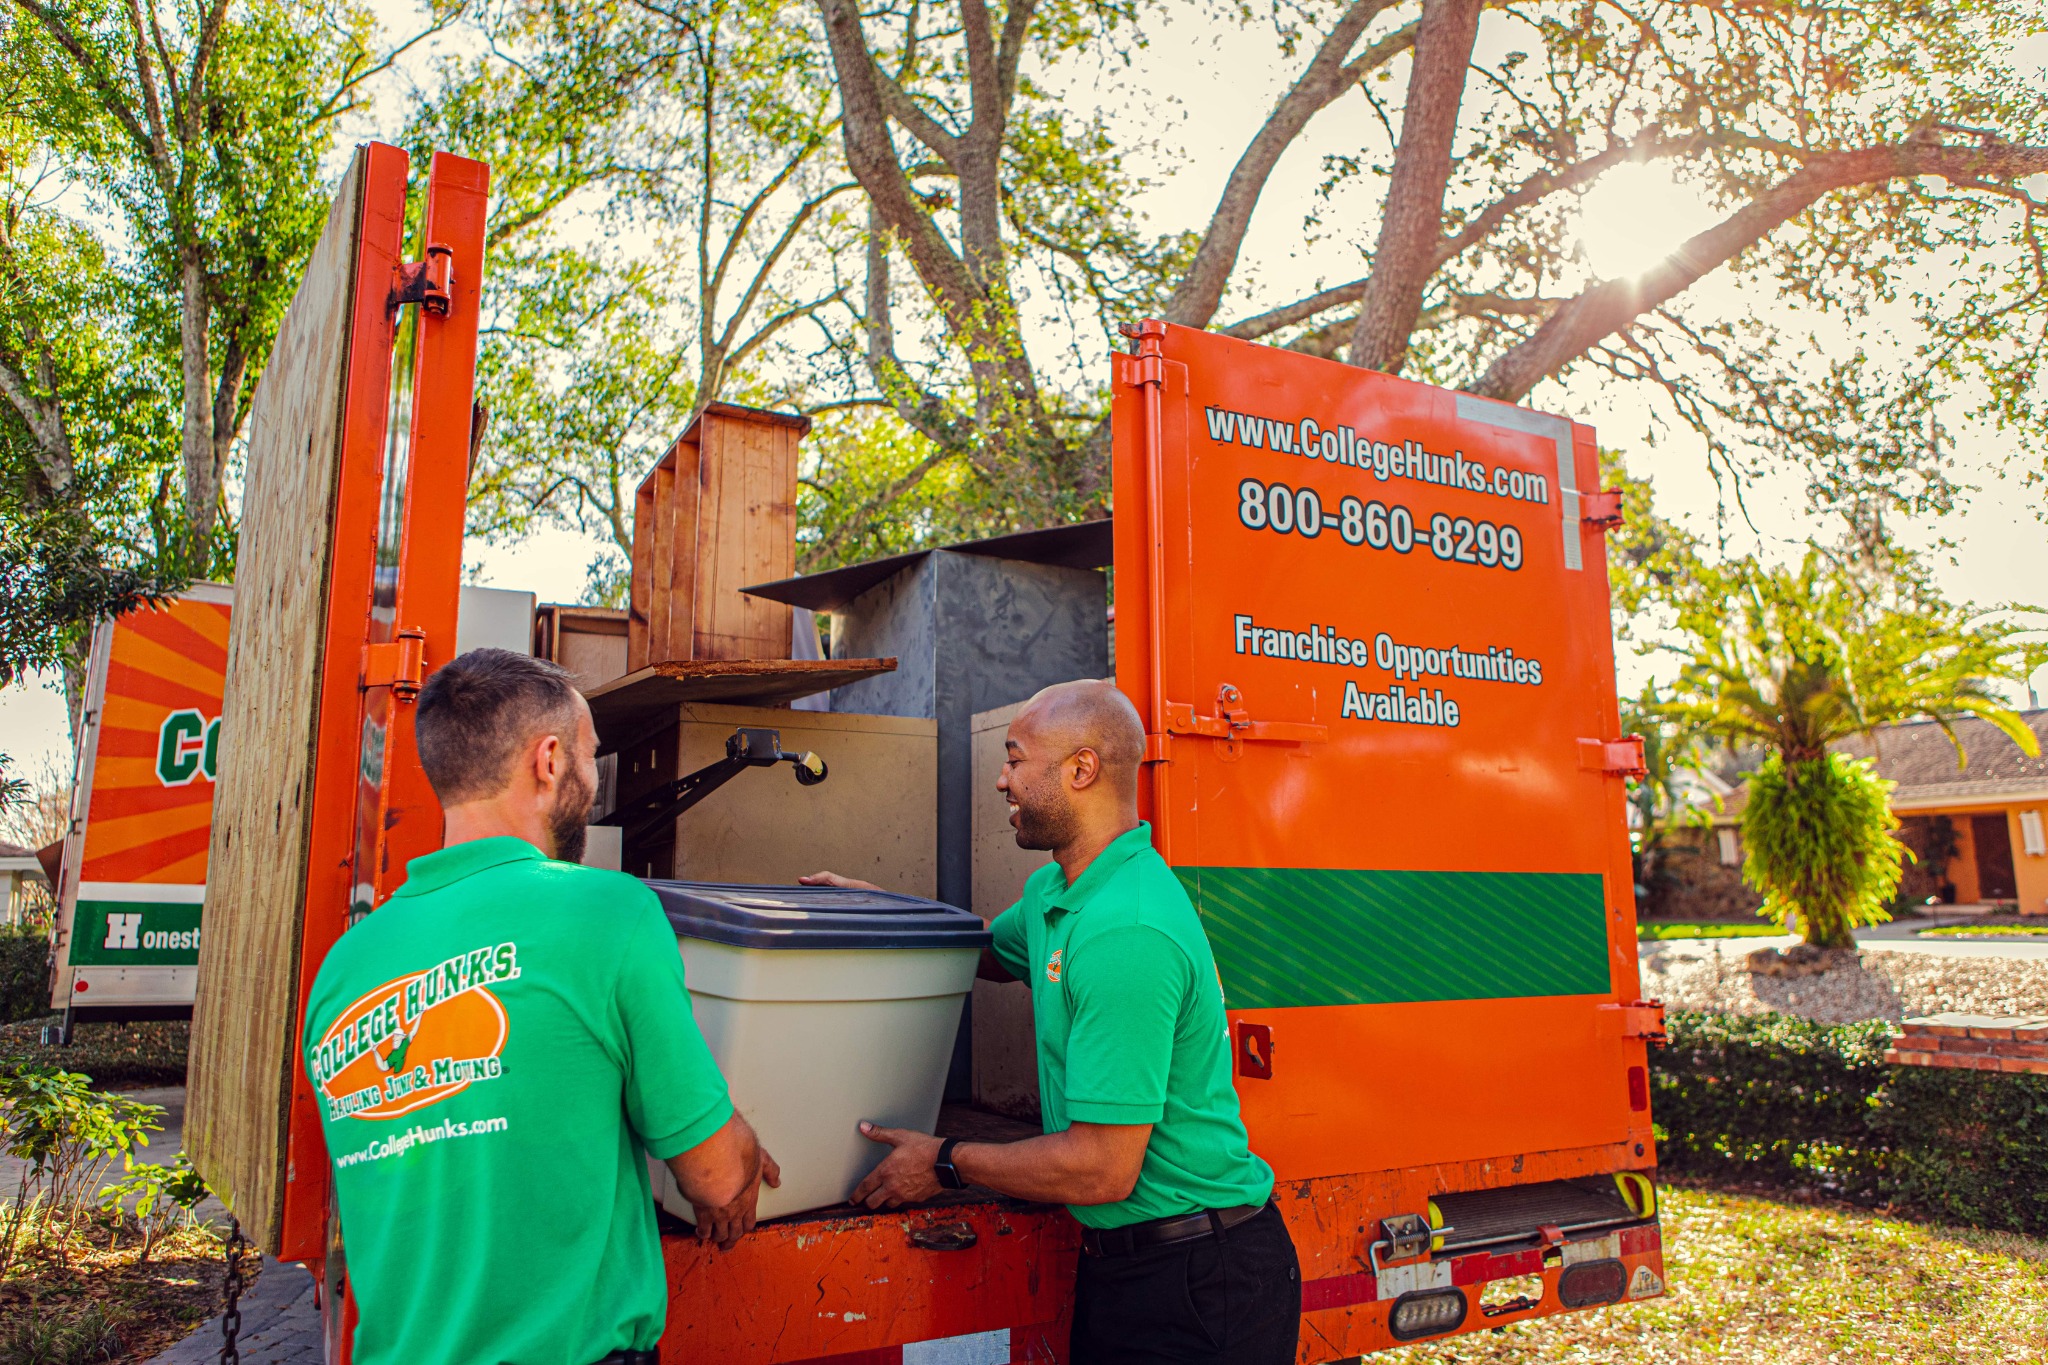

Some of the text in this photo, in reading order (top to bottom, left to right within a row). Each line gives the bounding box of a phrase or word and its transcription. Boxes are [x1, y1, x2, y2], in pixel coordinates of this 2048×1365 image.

[1205, 406, 1549, 504] www.CollegeHunks.com
[1238, 478, 1523, 571] 800-860-8299
[1234, 614, 1543, 685] Franchise Opportunities
[1341, 681, 1459, 727] Available
[104, 912, 200, 949] Honest
[311, 942, 521, 1092] COLLEGE H.U.N.K.S.
[414, 1066, 431, 1089] &
